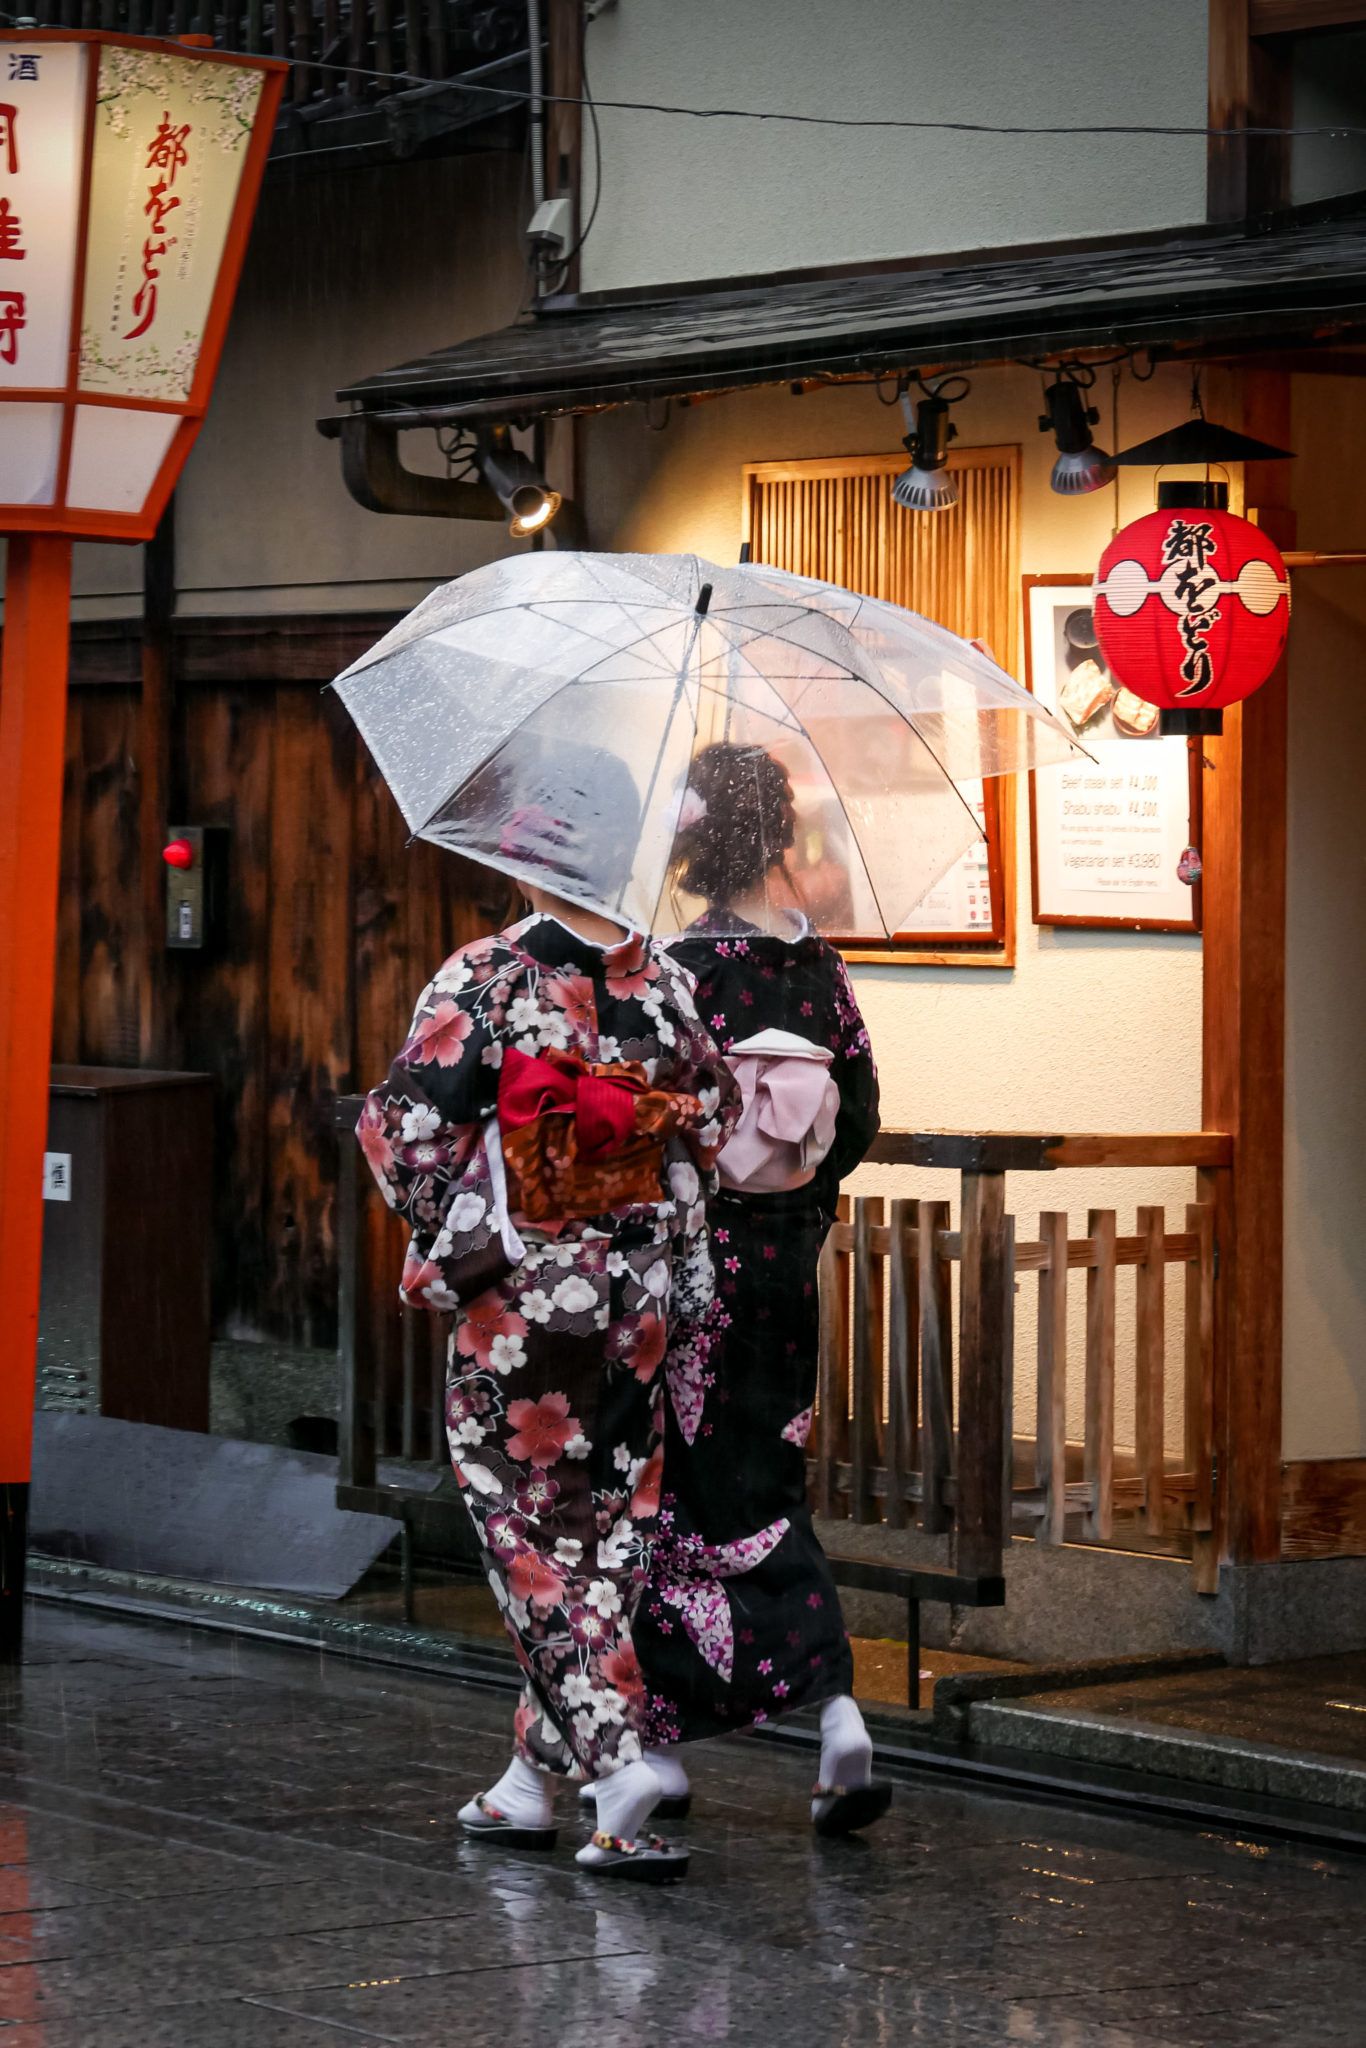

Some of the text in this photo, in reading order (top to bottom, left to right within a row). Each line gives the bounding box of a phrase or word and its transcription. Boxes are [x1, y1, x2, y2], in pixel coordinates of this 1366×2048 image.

[122, 111, 192, 340] 都をどり
[1161, 519, 1222, 698] 都をどり
